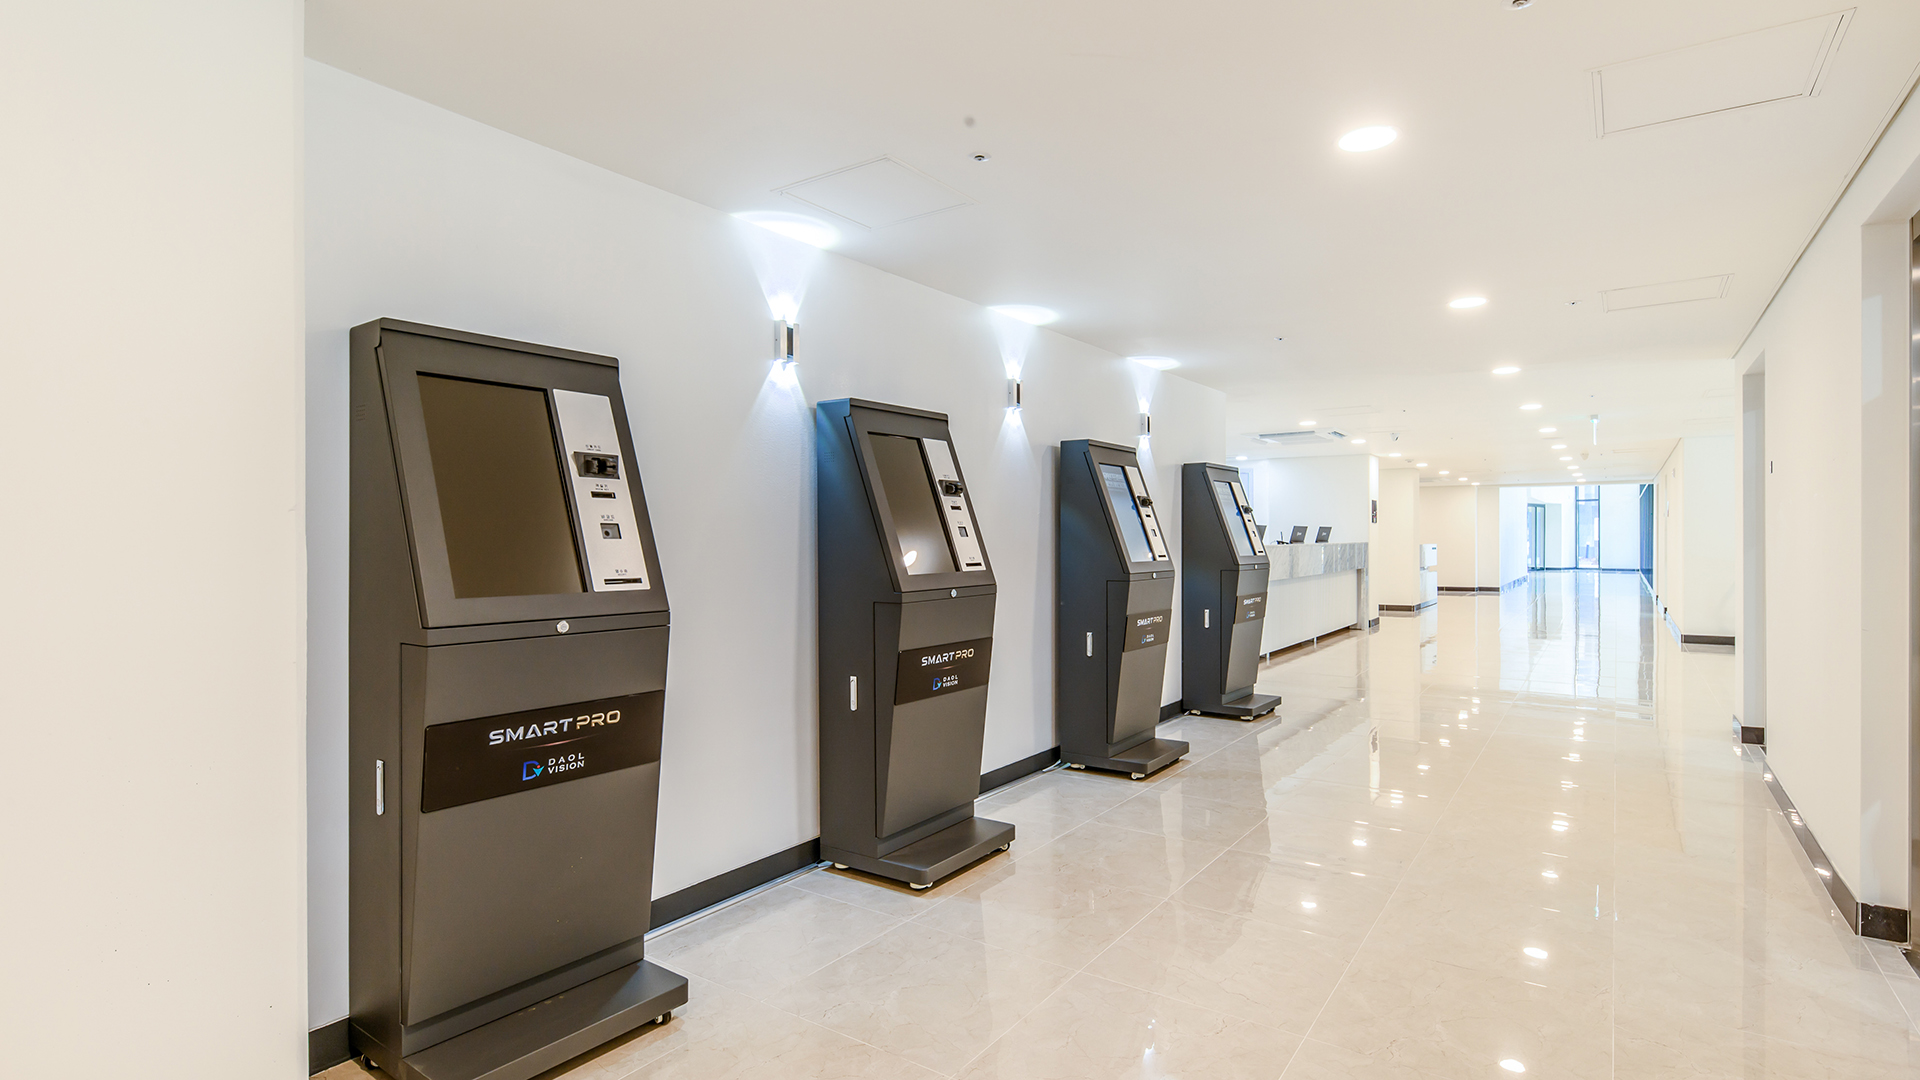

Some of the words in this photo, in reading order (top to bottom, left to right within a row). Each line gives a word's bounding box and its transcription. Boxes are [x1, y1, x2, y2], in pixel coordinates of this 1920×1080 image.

[489, 718, 573, 746] SMART
[575, 710, 621, 730] PRO
[549, 753, 585, 766] DAOL
[548, 760, 585, 774] VISION
